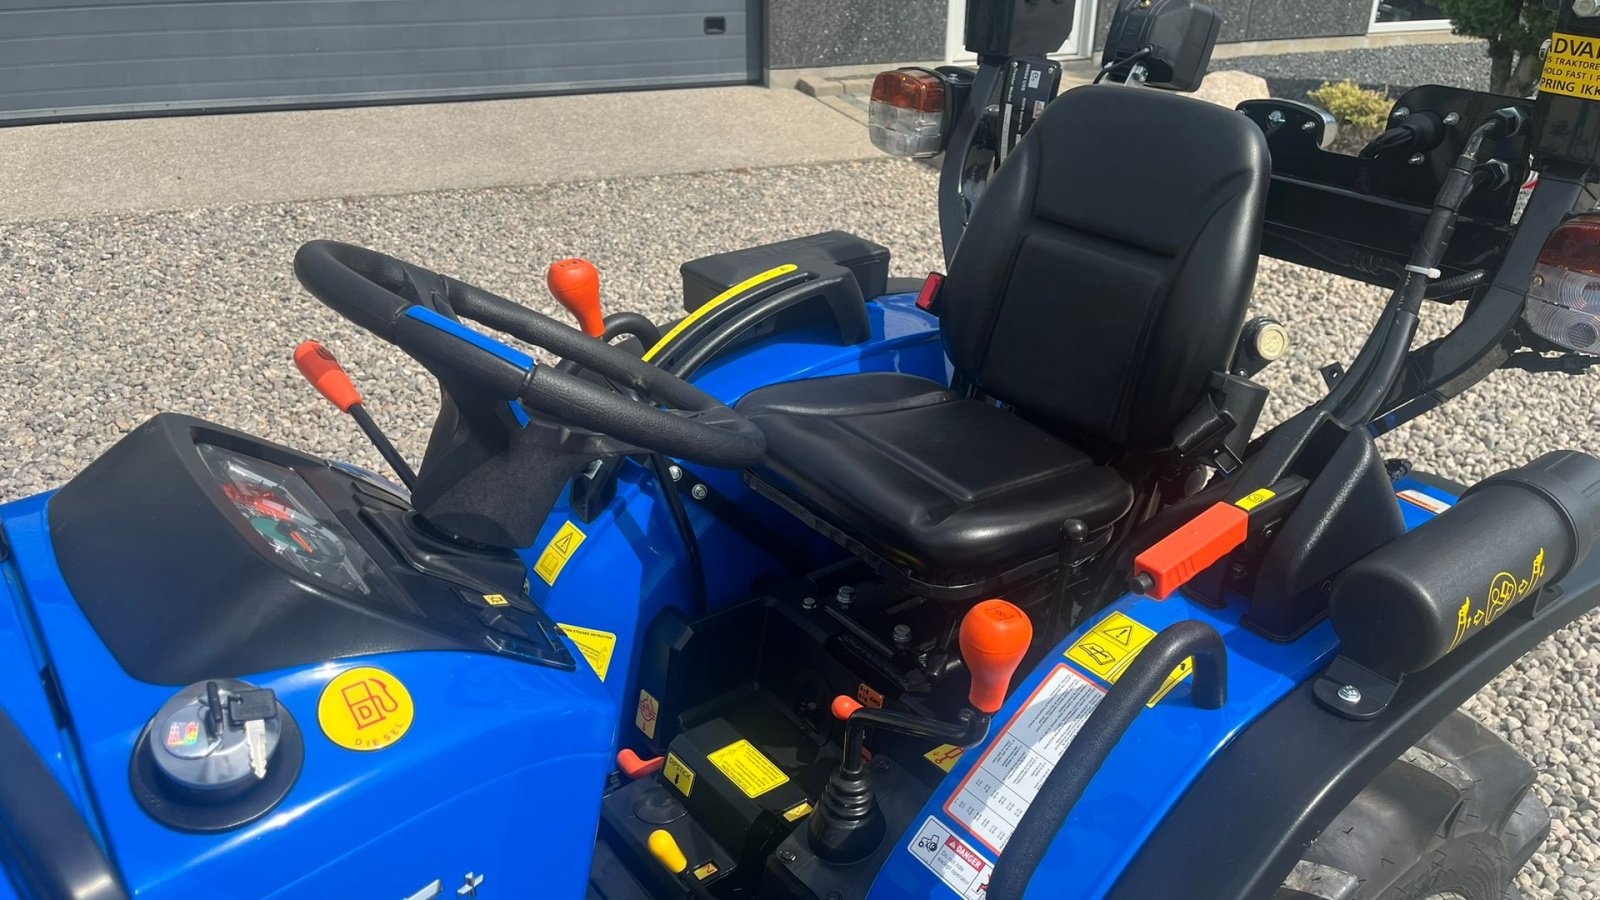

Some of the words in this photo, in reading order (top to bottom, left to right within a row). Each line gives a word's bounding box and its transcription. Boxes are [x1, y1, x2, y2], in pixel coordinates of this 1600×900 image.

[1549, 38, 1600, 59] DVA
[1566, 70, 1587, 80] FAST
[358, 705, 372, 720] D
[355, 723, 404, 747] DIESEL
[669, 757, 691, 780] DIPSTICK
[956, 845, 981, 868] DANGER
